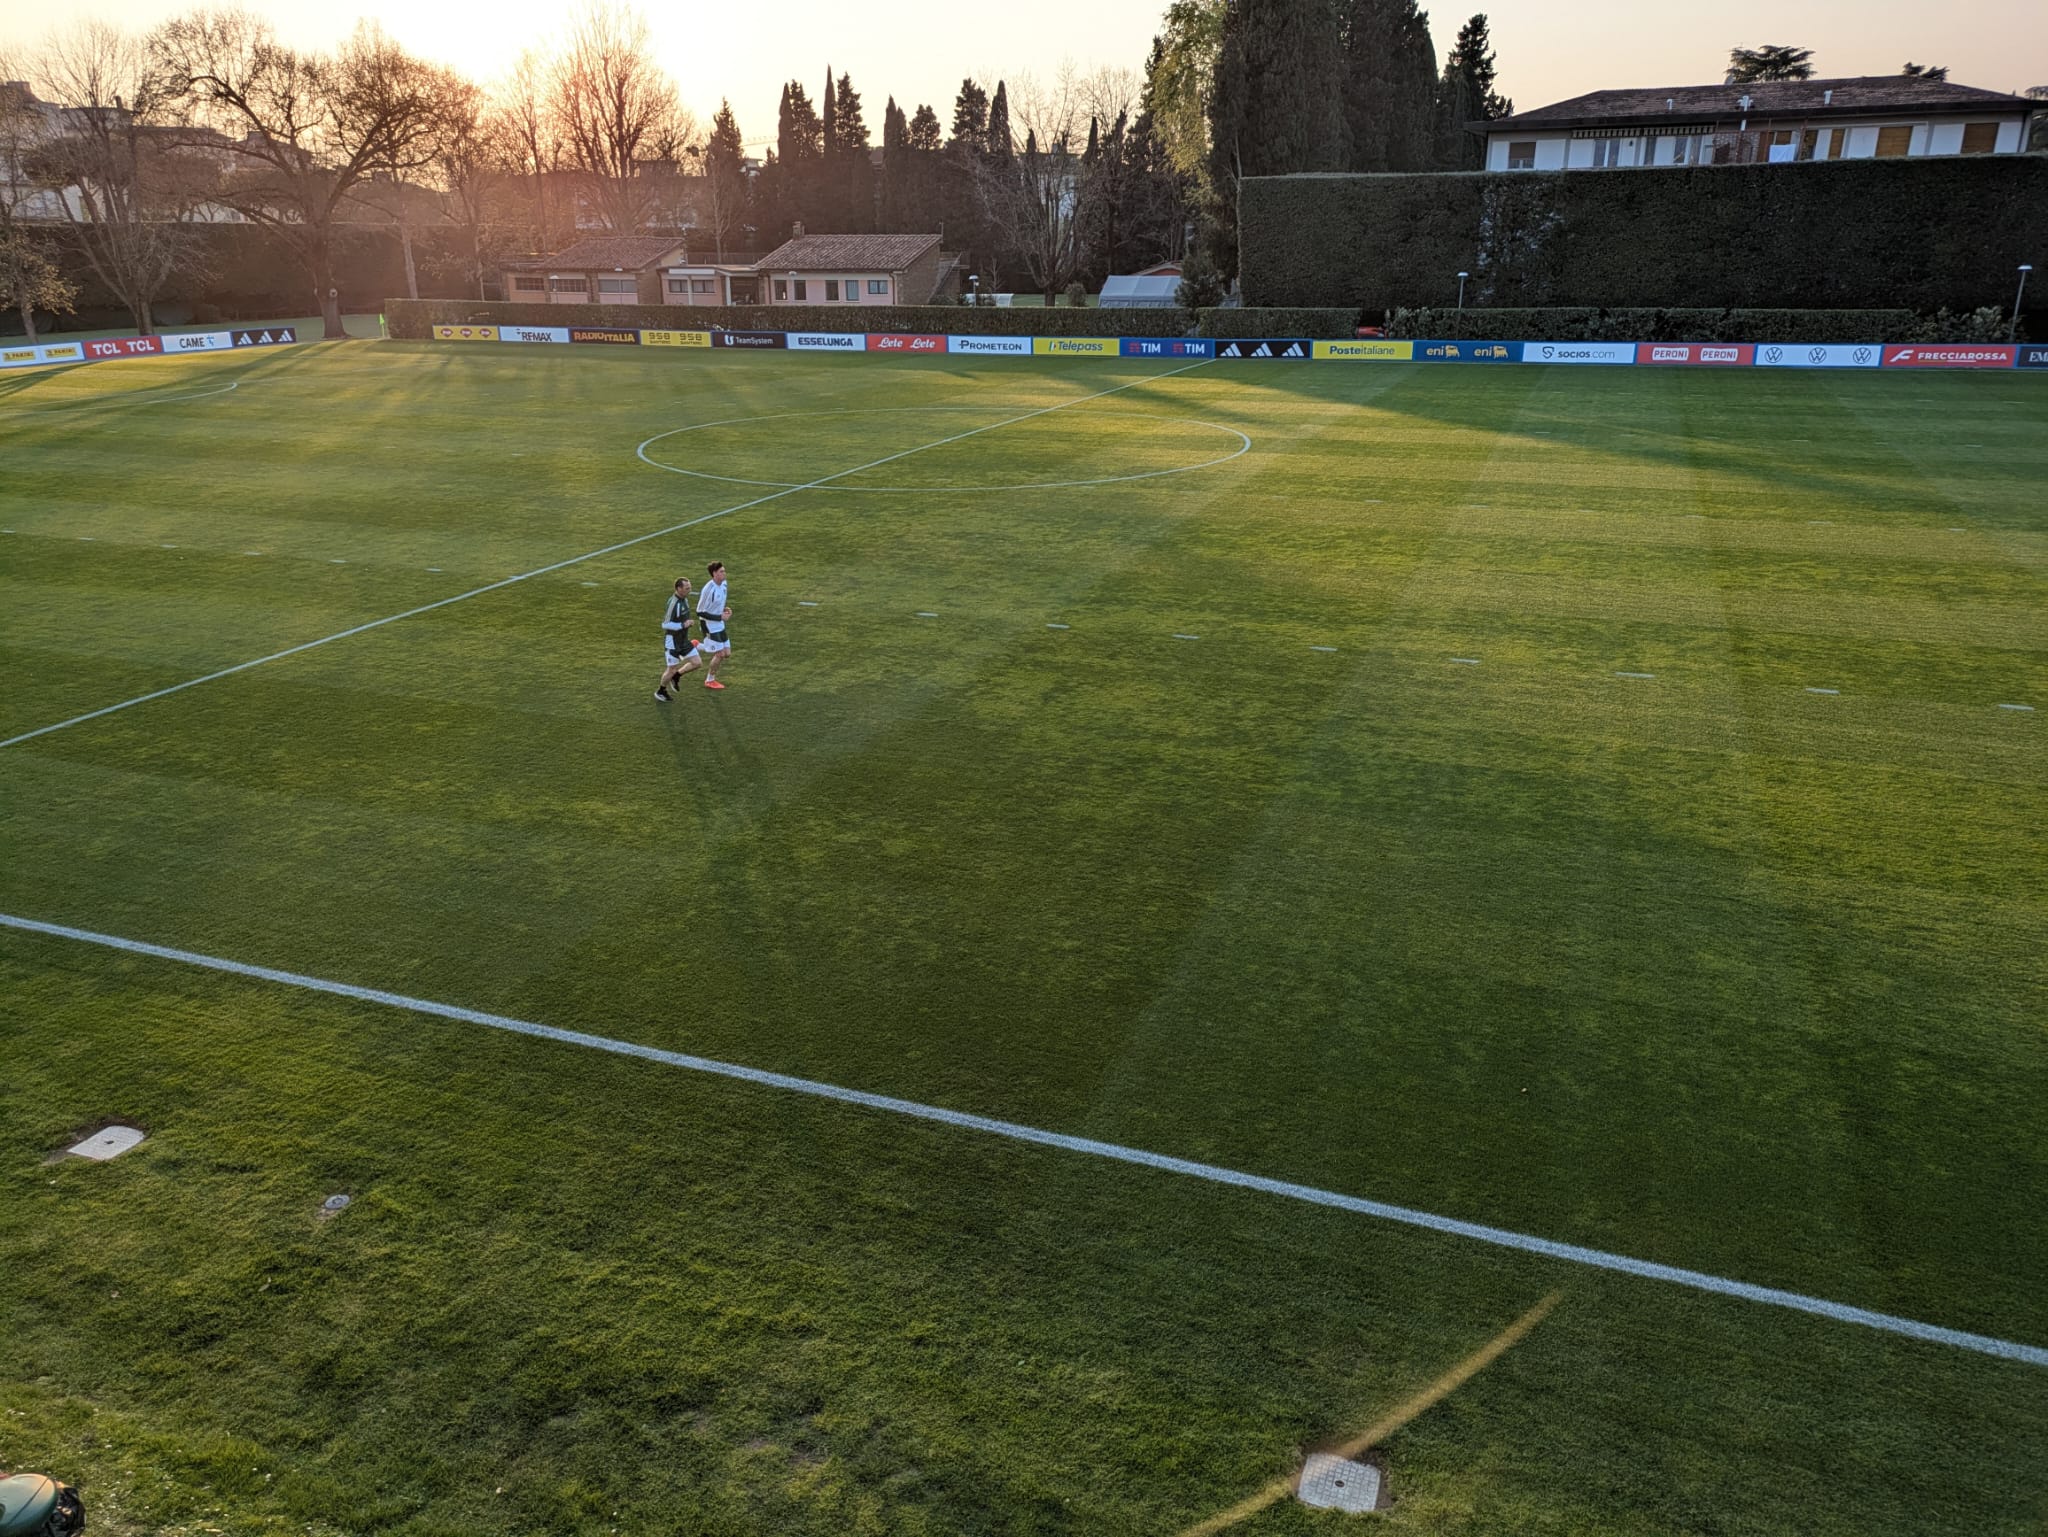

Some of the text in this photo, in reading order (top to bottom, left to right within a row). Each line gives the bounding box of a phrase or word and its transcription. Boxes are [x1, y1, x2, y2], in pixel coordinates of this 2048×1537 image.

[179, 337, 205, 348] CAME
[735, 336, 774, 346] TeamSystem
[798, 337, 853, 347] ESSELUNGA
[877, 337, 936, 349] Lete Lete
[1058, 341, 1103, 352] Telepass
[92, 339, 155, 355] TCL TCL
[1141, 343, 1205, 354] TIM TIM
[1426, 345, 1492, 357] eni eni
[1653, 350, 1736, 359] PERONI PERONI
[1918, 352, 2008, 360] FRECCIAROSSA
